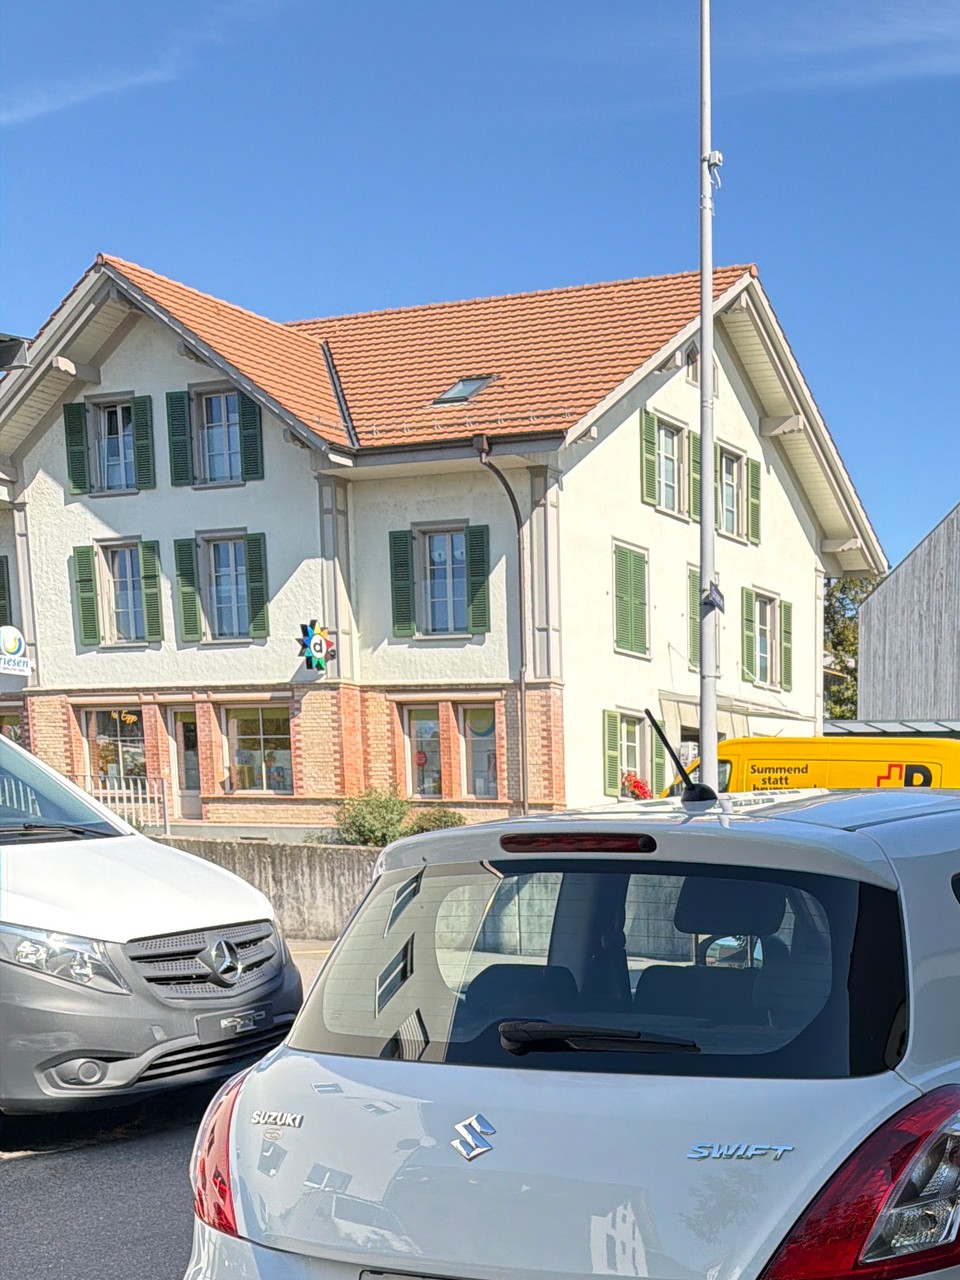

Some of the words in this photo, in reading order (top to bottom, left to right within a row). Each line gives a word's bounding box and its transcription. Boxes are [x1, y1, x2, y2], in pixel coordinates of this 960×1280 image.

[750, 764, 809, 774] Summend
[761, 776, 789, 785] statt
[251, 1110, 304, 1129] SUZUKI
[687, 1142, 794, 1161] SWIFT
